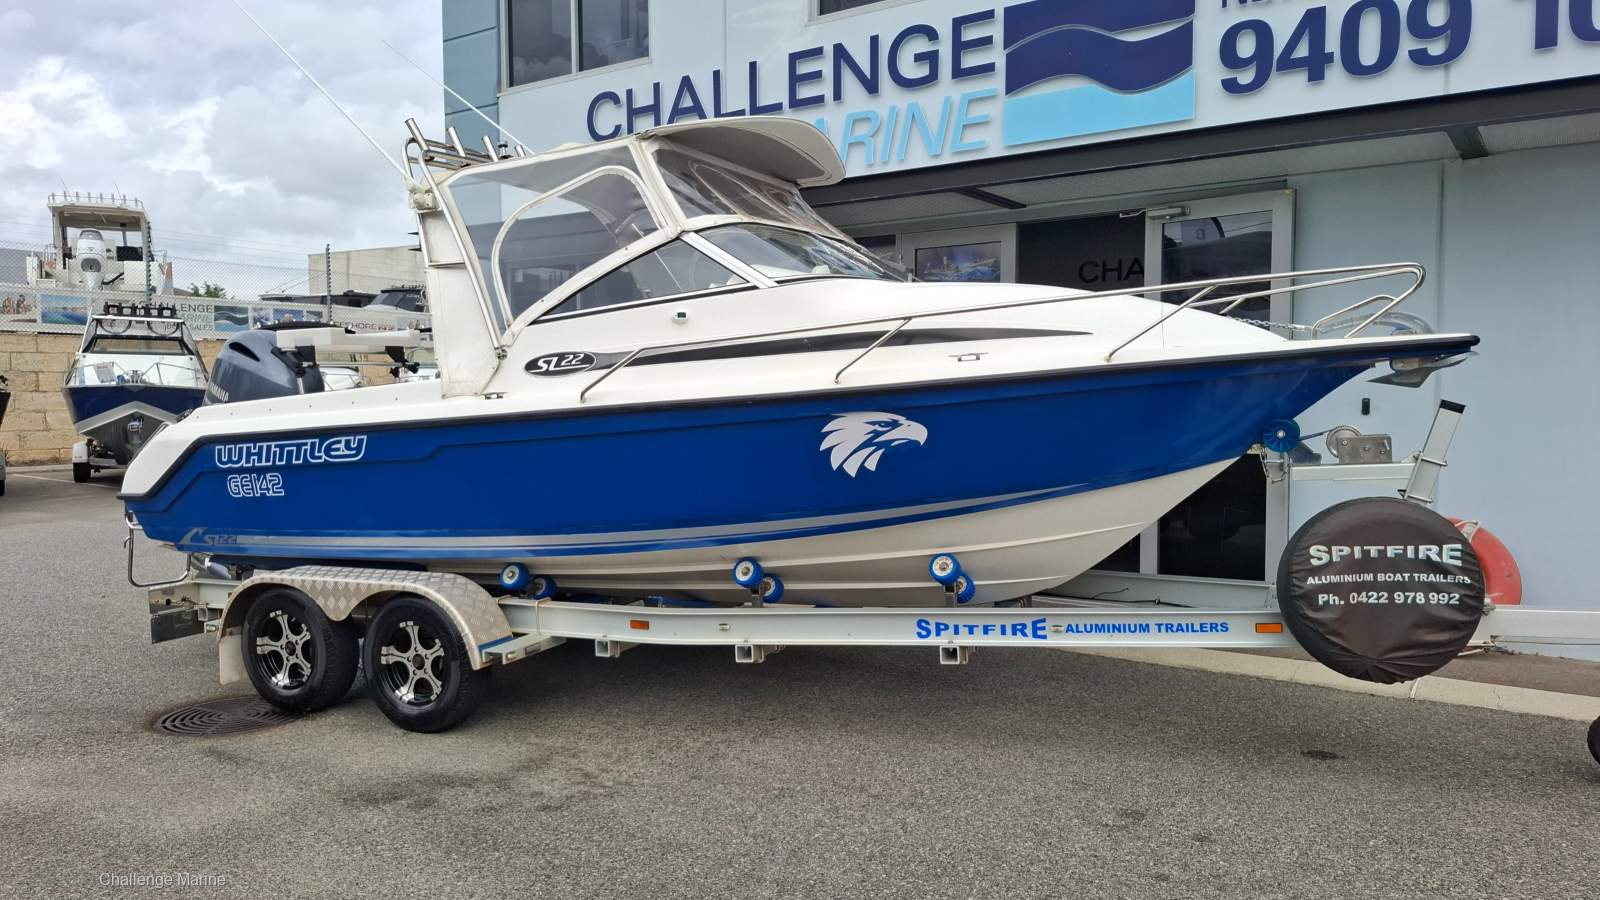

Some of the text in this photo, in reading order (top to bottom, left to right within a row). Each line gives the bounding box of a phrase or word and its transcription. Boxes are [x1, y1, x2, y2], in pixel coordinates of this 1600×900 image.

[1219, 0, 1472, 95] 9409
[586, 8, 996, 142] CHALLENGE
[811, 88, 998, 166] RINE
[215, 435, 367, 467] WHITTLEY
[227, 473, 284, 498] GE142
[1309, 543, 1463, 567] SPITFIRE
[1306, 572, 1471, 585] ALUMINIUM BOAT TRAILERS
[1318, 591, 1460, 606] Ph. 0422 978 992
[915, 617, 1229, 641] SPITFIRE ALUMINIUM TRAILERS
